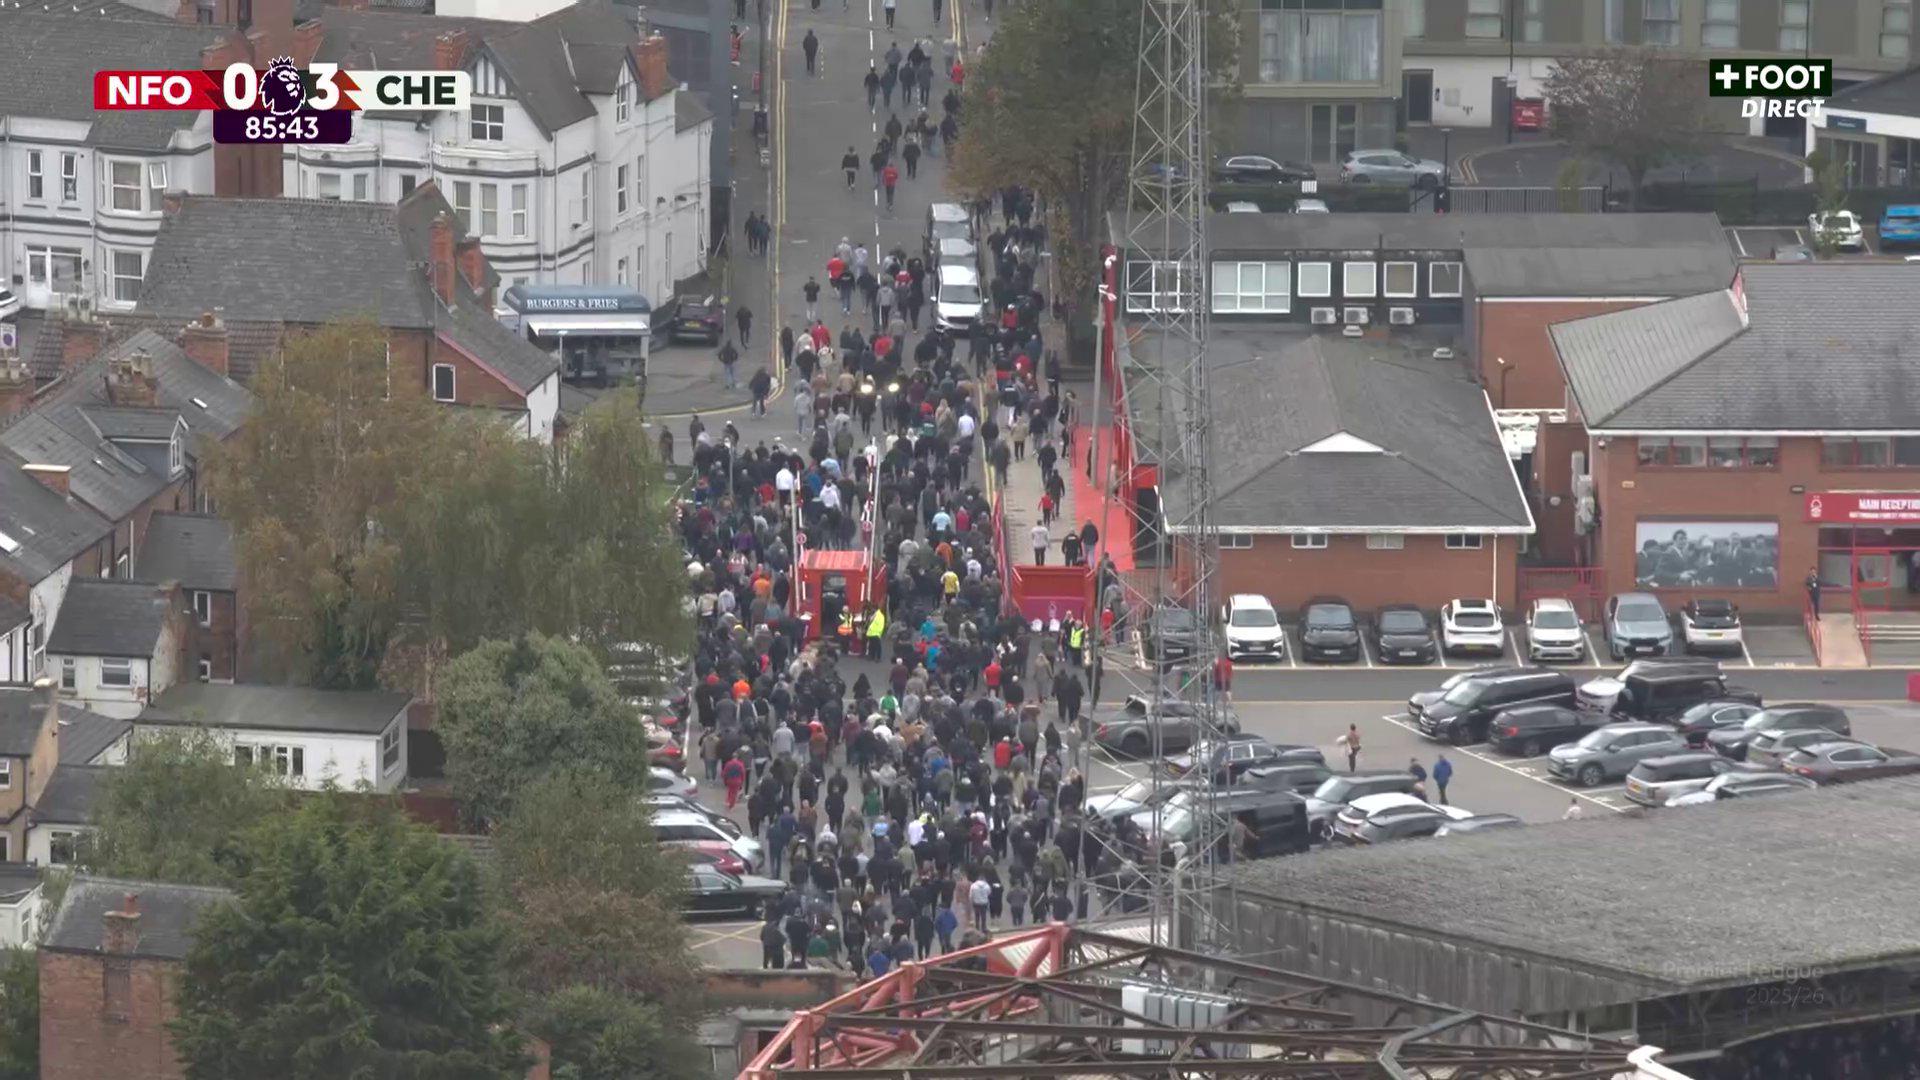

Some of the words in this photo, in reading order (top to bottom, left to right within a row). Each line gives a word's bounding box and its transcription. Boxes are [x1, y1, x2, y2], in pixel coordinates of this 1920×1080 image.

[526, 298, 576, 310] BURGERS
[577, 298, 586, 309] &
[588, 298, 619, 309] FRIES
[1859, 499, 1880, 509] MAIN
